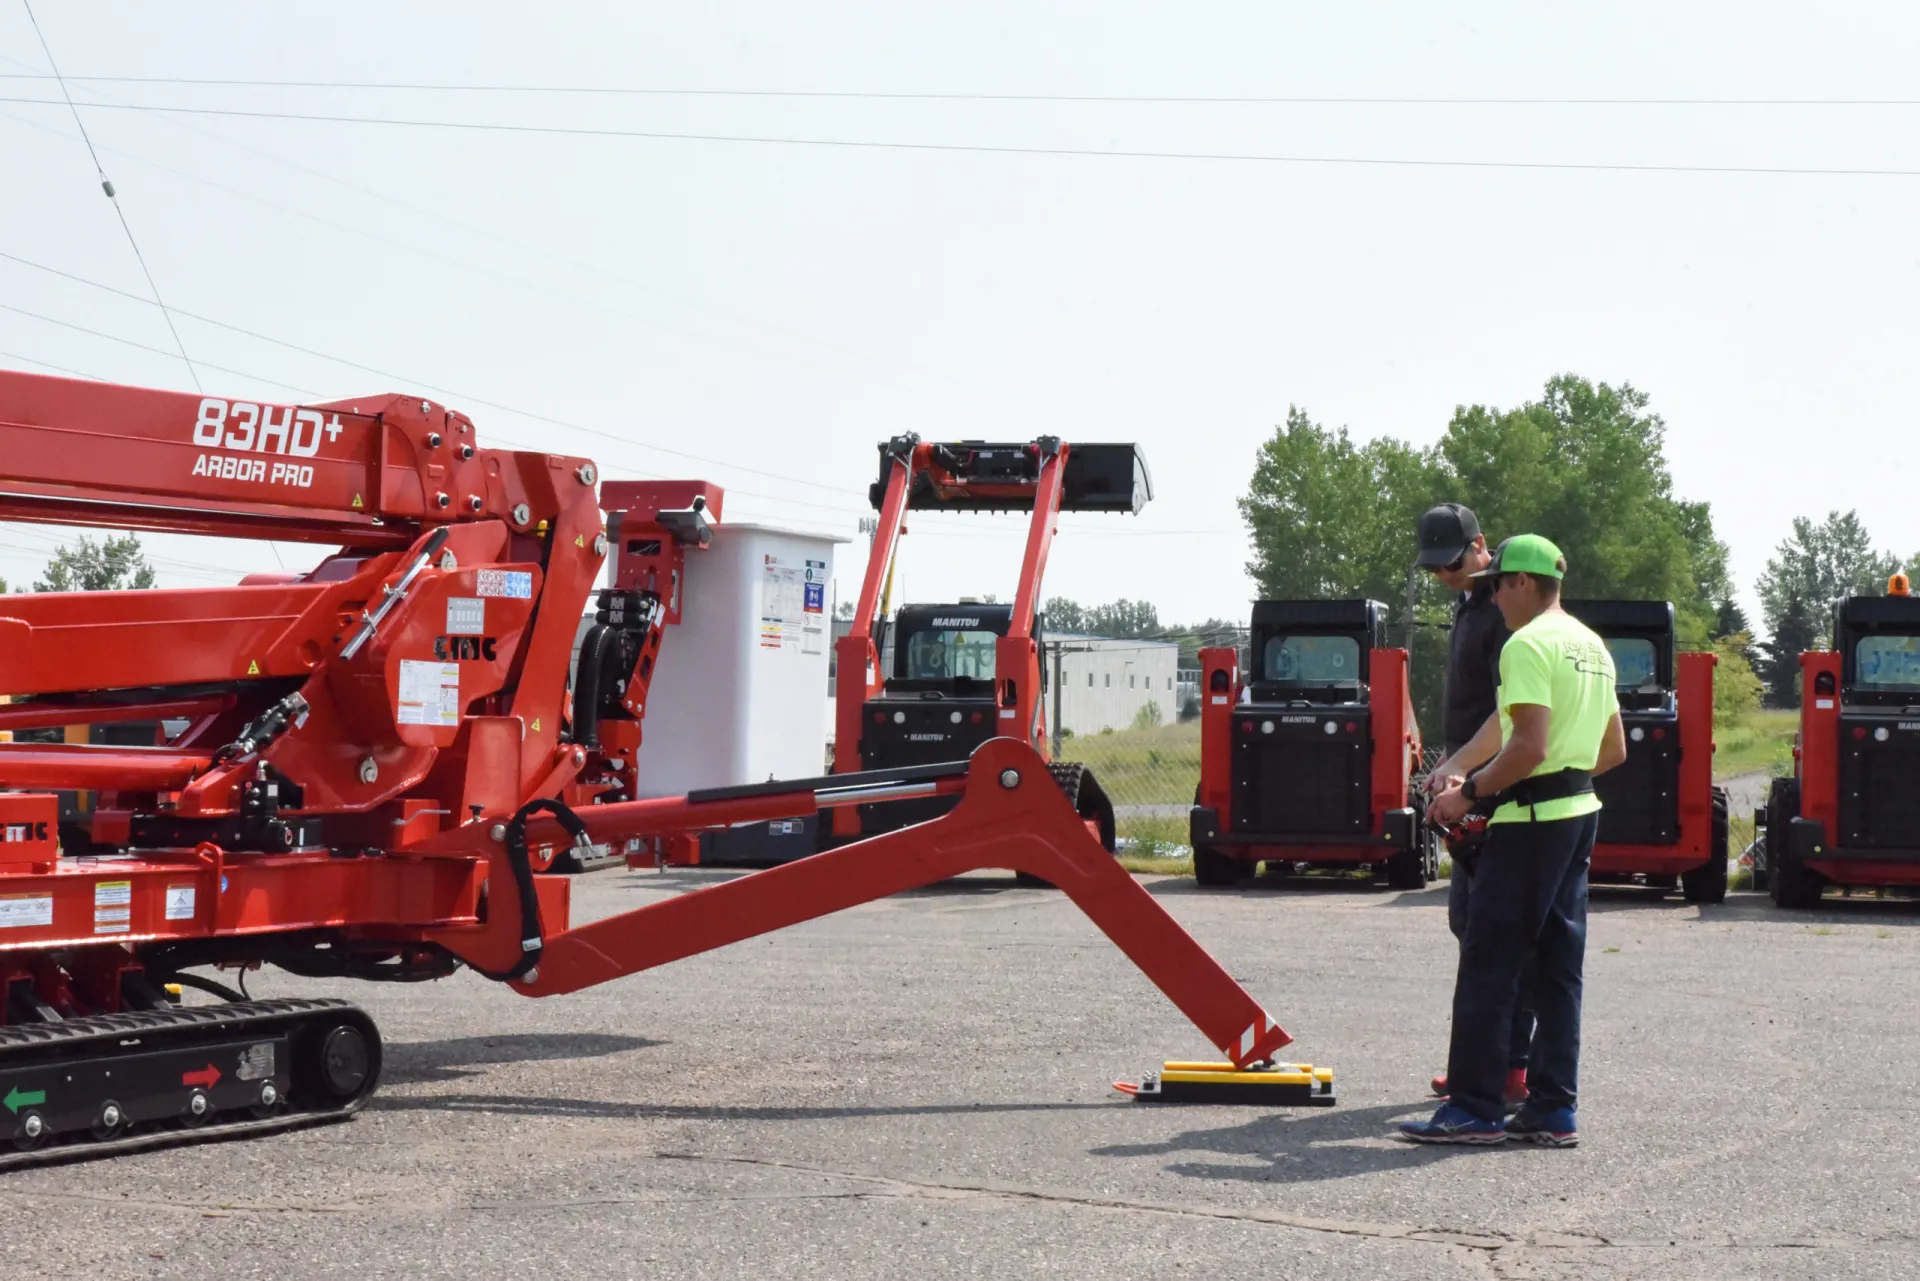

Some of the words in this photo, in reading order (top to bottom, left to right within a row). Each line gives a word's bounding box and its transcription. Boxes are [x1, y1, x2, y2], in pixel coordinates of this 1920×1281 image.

[192, 454, 267, 483] ARBOR
[270, 463, 314, 488] PRO
[932, 617, 979, 627] MANITOU
[1281, 716, 1316, 724] MANITOU
[910, 733, 944, 742] MANITOU
